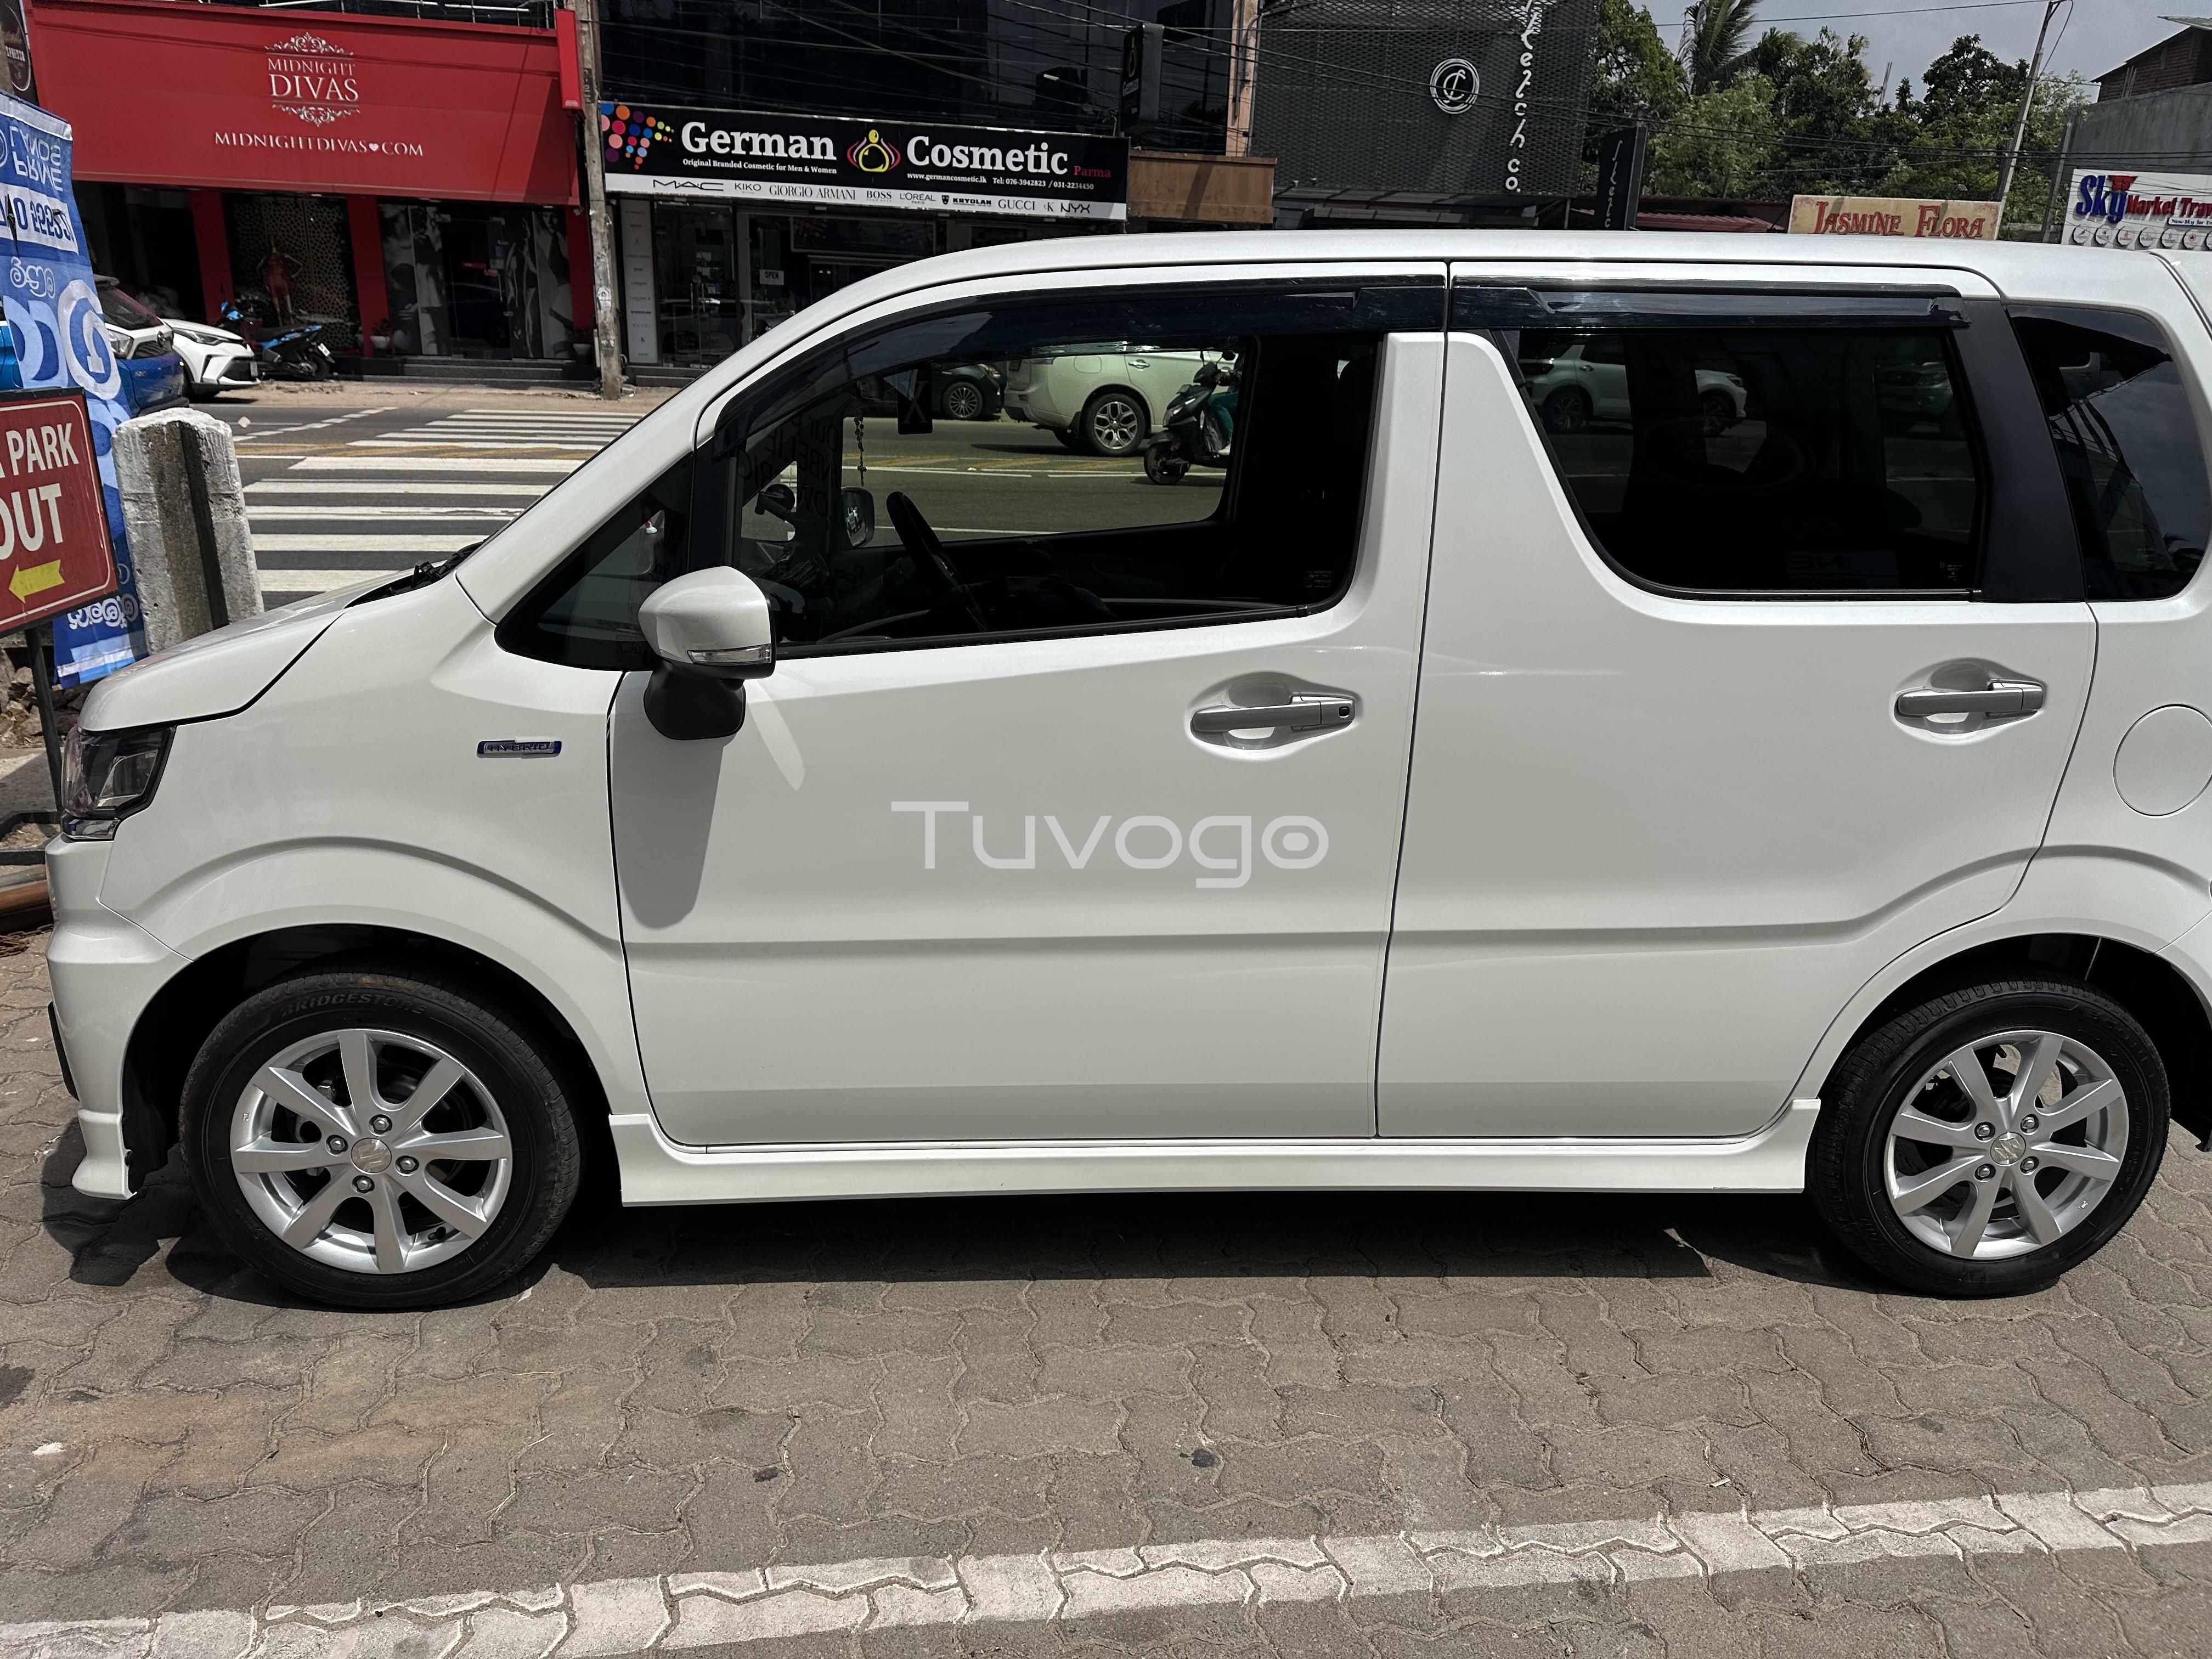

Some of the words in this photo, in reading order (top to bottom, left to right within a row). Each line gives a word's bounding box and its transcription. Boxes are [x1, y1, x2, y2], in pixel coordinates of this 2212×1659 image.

[268, 58, 356, 76] MIDNIGHT
[268, 74, 359, 102] DIVAS
[681, 121, 837, 160] German
[906, 136, 1068, 174] Cosmetic
[1073, 166, 1111, 178] Parma
[682, 159, 712, 167] Original
[713, 160, 742, 168] Branded
[907, 172, 987, 184] www.germancosmetic.lk
[1006, 178, 1046, 188] 076-3942823
[734, 182, 762, 192] KIKO
[769, 184, 813, 198] GIORGIO
[816, 187, 856, 200] ARMANI
[866, 190, 892, 199] BOSS
[998, 199, 1036, 211] GUCCI
[1060, 203, 1091, 213] NYX
[2075, 175, 2128, 224] Sky
[2125, 194, 2178, 216] Market
[1813, 201, 1904, 236] JASMINE
[1914, 205, 1985, 238] FLORA
[764, 271, 779, 279] OPEN
[5, 422, 79, 476] PARK
[489, 743, 549, 752] HYBRID
